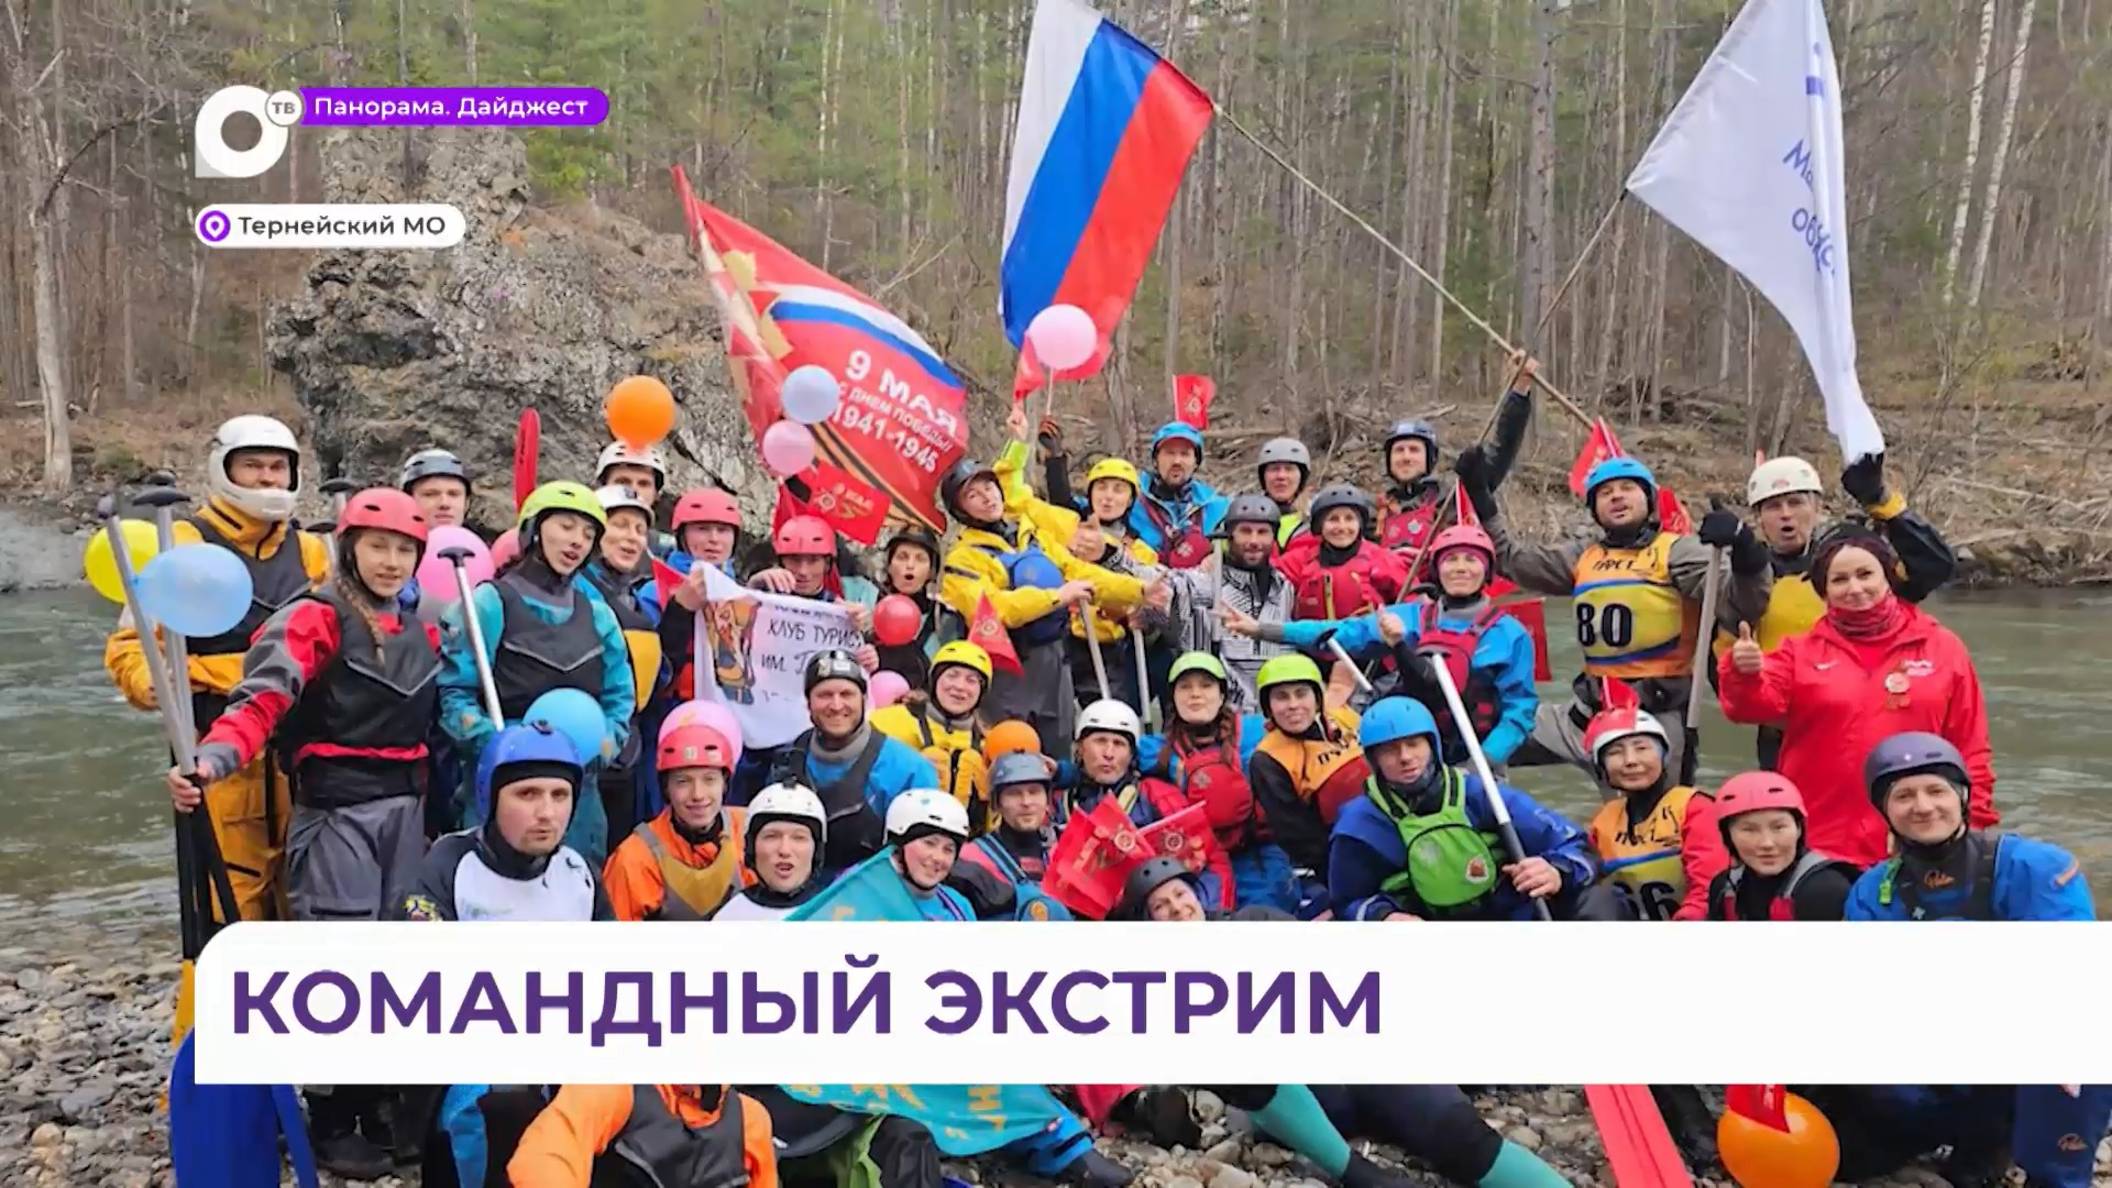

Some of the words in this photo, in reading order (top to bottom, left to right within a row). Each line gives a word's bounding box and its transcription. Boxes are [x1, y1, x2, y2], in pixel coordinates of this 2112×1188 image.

[845, 350, 872, 381] 9
[879, 368, 957, 437] МАЯ
[833, 400, 939, 473] 1941-1945
[768, 619, 805, 641] КЛУБ
[1576, 603, 1632, 647] 80
